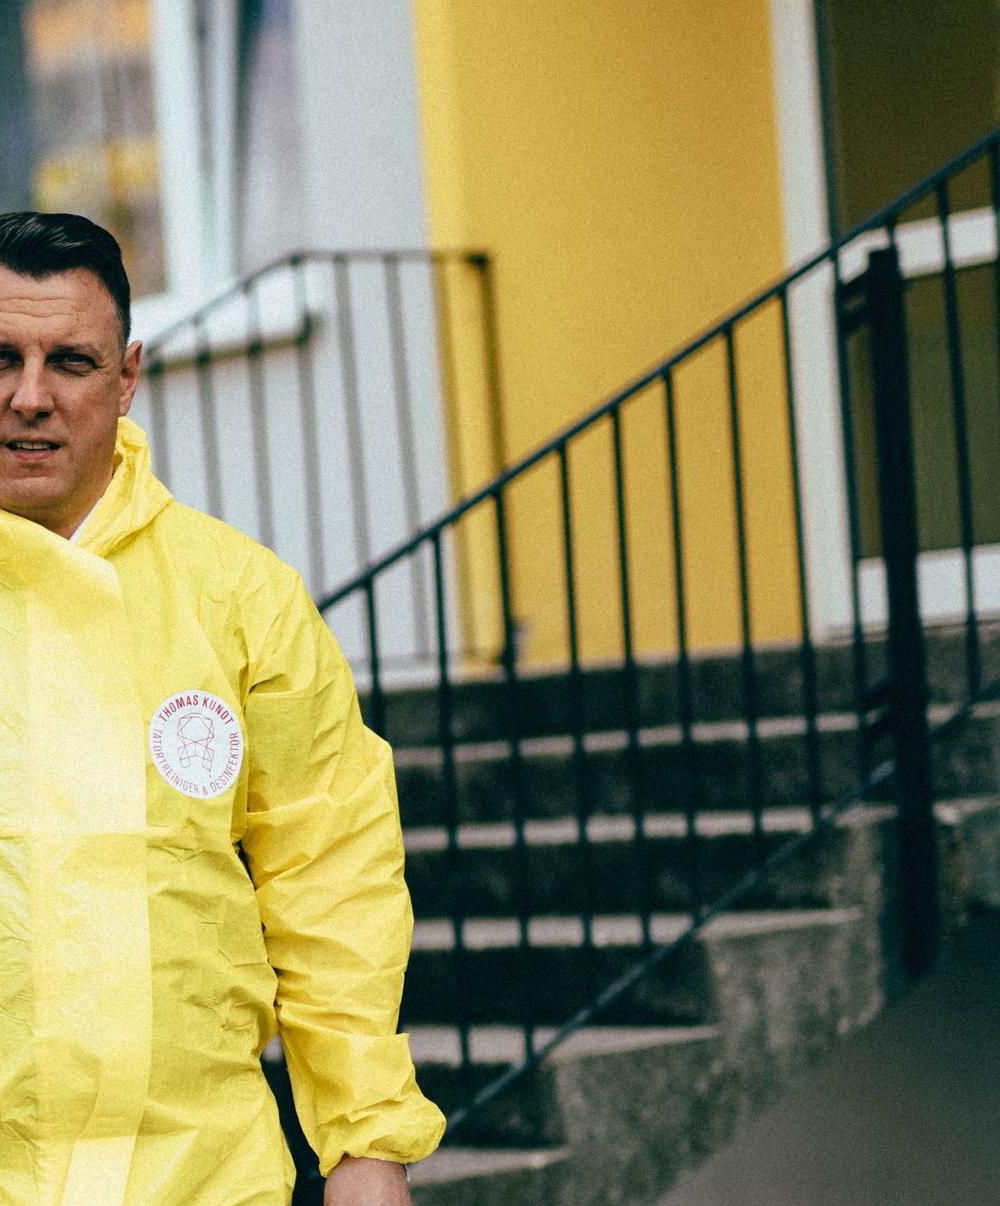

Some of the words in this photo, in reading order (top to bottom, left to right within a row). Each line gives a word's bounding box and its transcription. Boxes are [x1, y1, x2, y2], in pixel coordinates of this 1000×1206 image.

[158, 694, 199, 722] THOMAS
[202, 696, 235, 725] KUNDT
[152, 728, 200, 795] TATORTREINIGER
[209, 731, 240, 793] DESINFEKTOR
